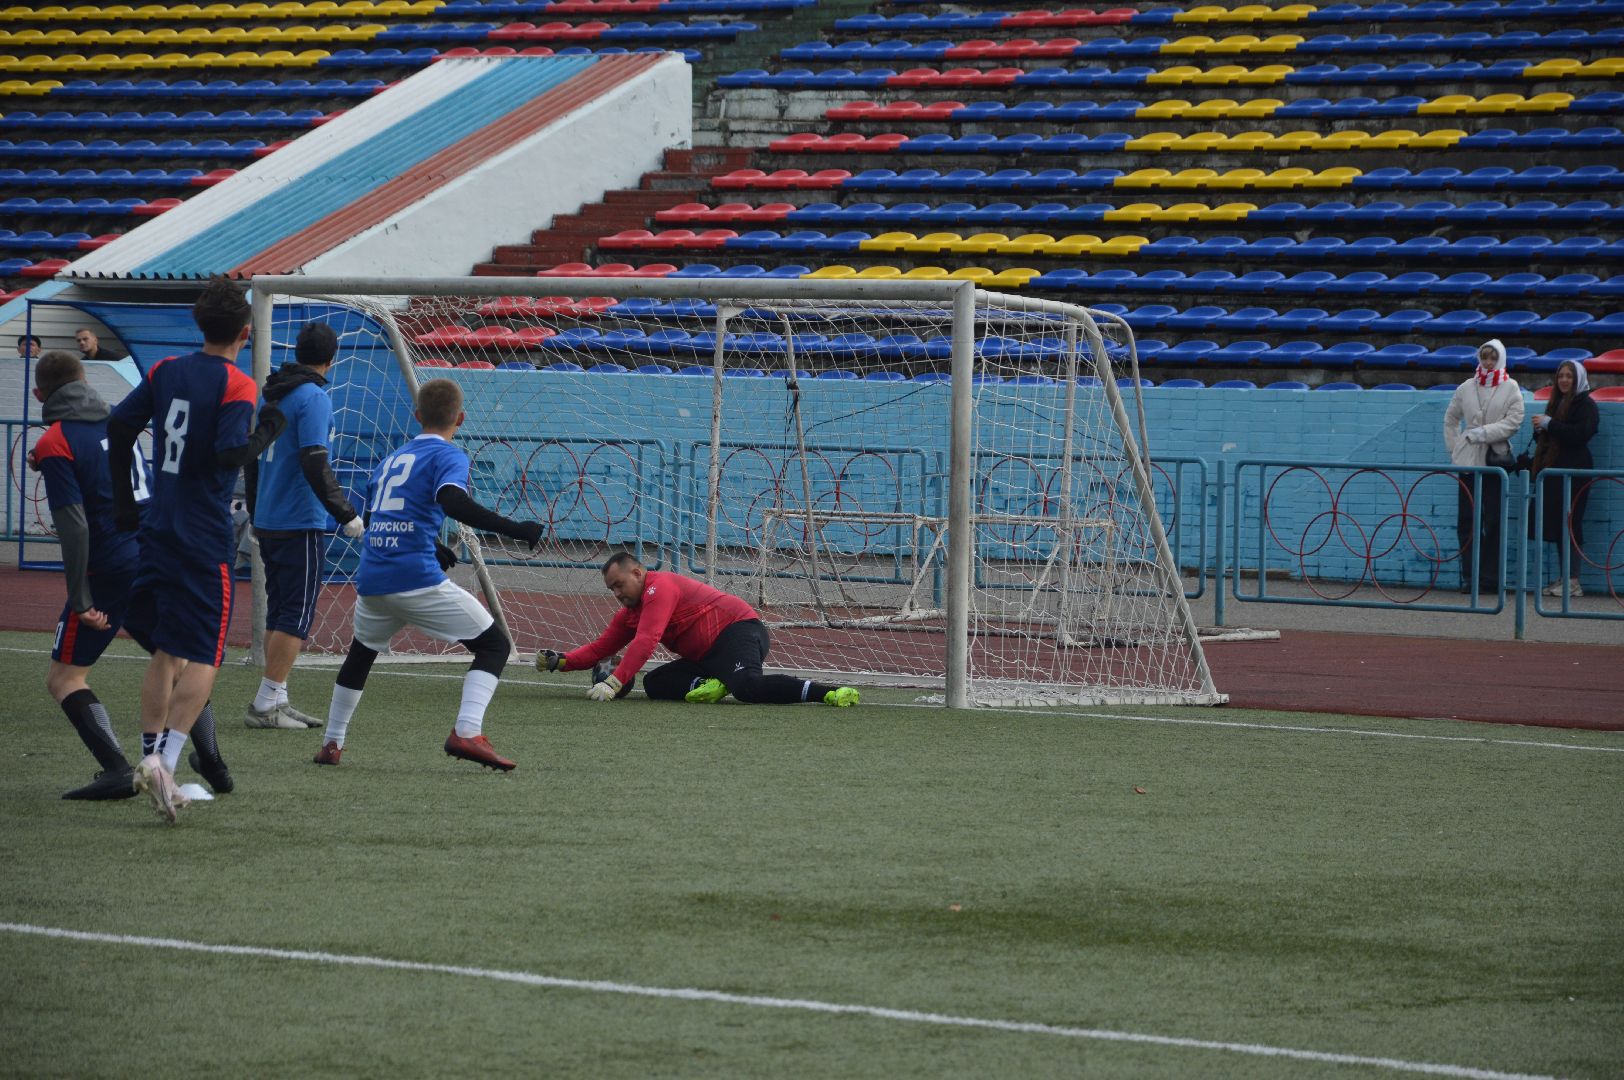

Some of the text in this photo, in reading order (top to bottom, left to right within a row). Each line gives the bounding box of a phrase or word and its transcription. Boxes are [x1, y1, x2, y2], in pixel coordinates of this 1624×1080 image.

[161, 398, 190, 475] 8
[370, 453, 416, 513] 12
[385, 536, 399, 548] ГХ
